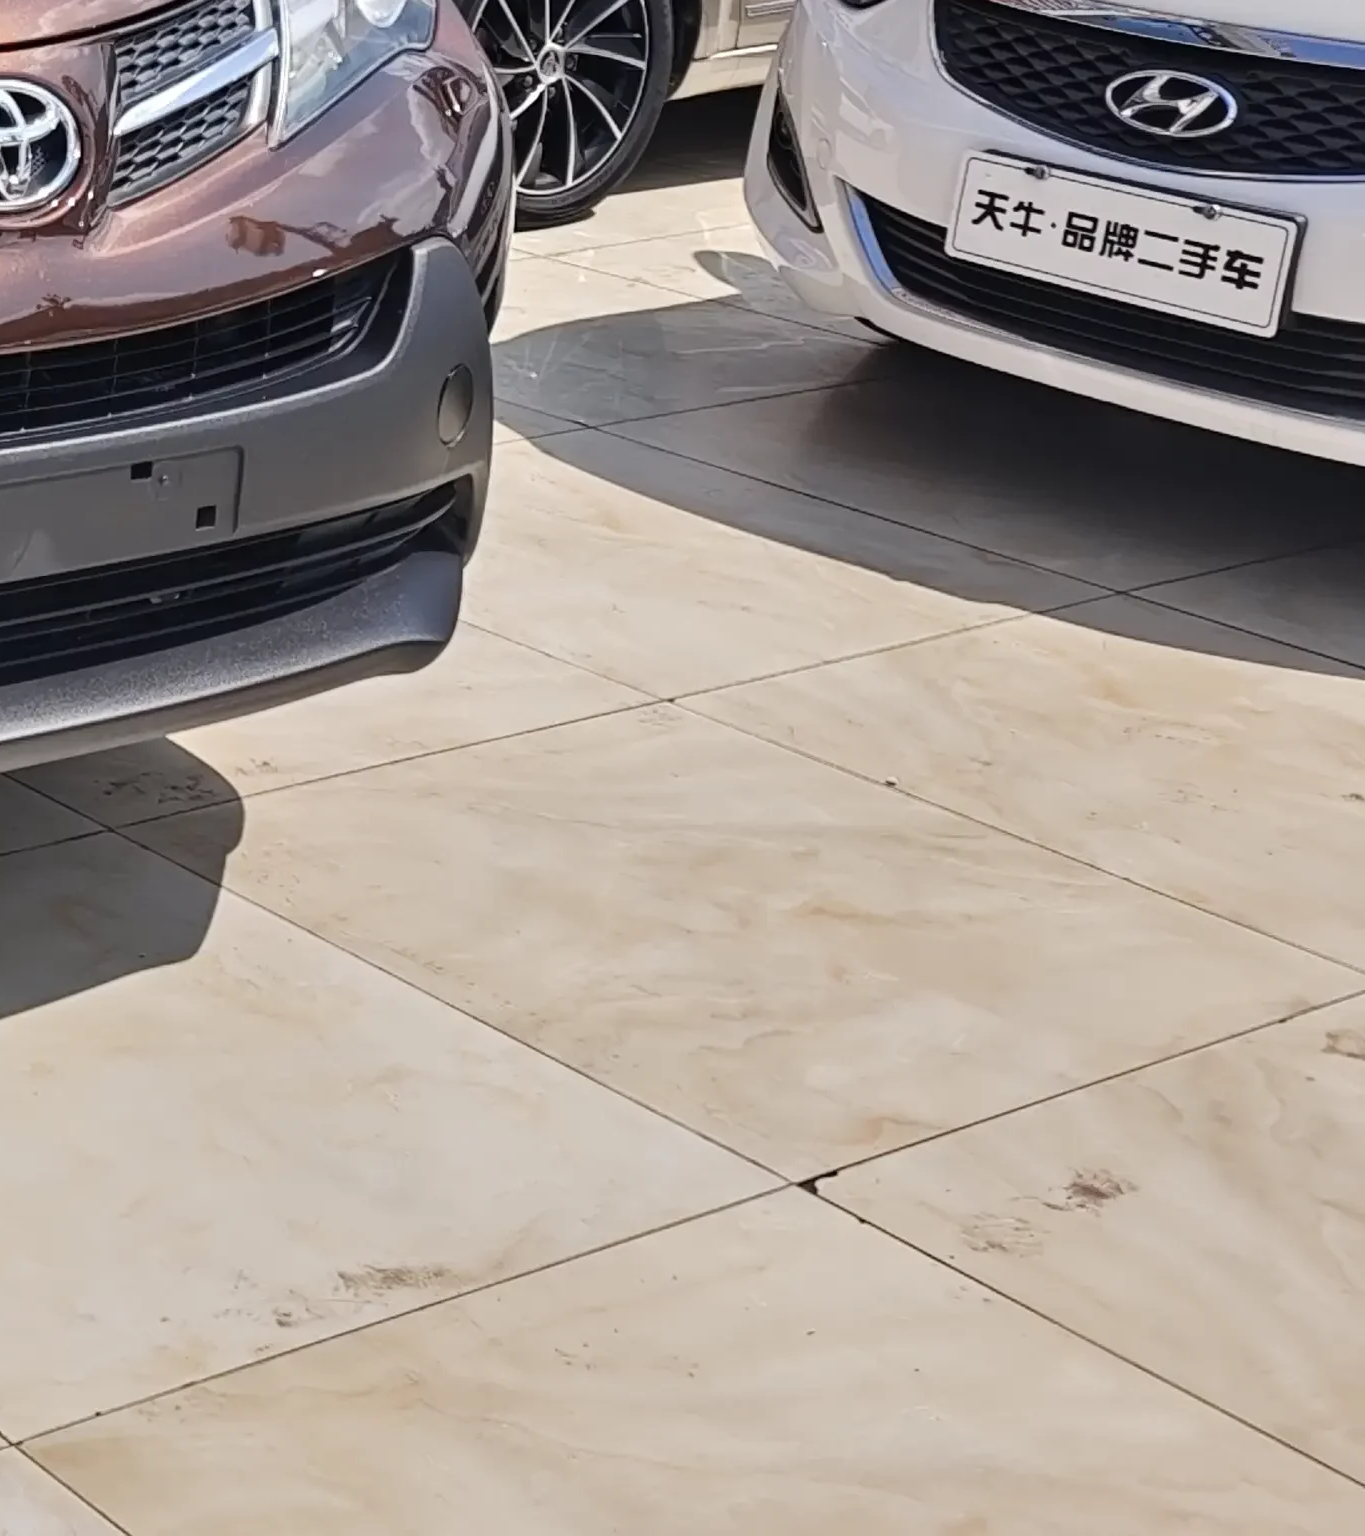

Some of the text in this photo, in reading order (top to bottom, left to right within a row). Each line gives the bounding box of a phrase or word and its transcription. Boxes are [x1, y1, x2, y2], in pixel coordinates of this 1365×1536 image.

[972, 188, 1265, 291] 天牛·品牌二手车
